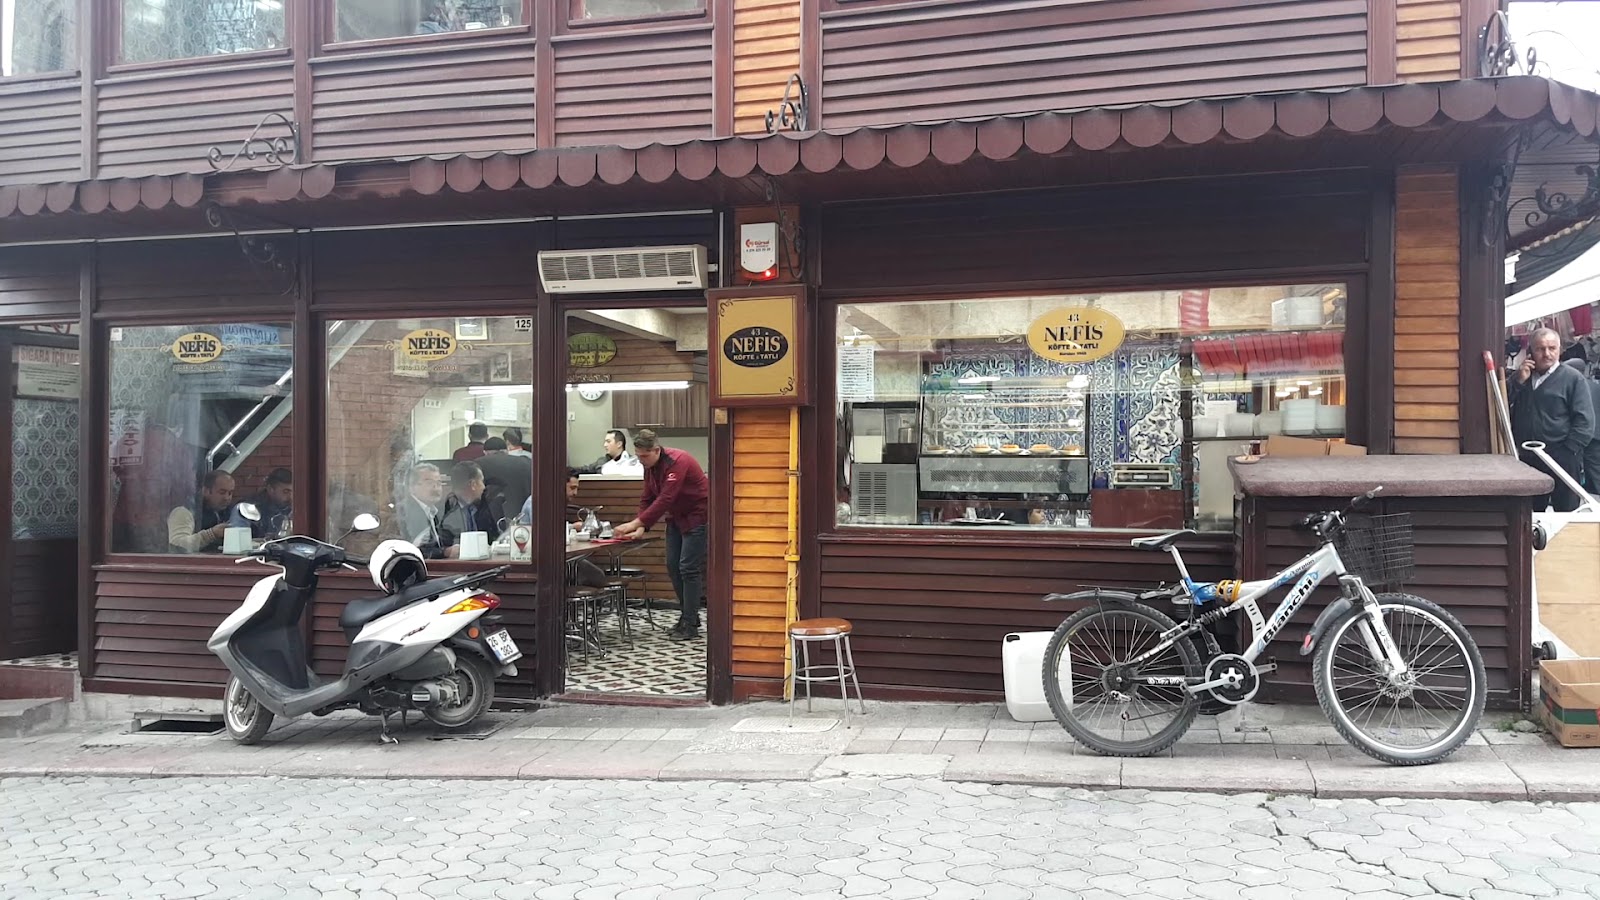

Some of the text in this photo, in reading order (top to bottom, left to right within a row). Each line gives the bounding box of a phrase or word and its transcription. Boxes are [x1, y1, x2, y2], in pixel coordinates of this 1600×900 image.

[1067, 313, 1080, 322] 43
[515, 319, 531, 328] 125
[751, 328, 761, 336] 43
[1044, 320, 1104, 342] NEFİS
[178, 336, 217, 353] NEFİS
[408, 333, 450, 350] NEFİS
[731, 331, 781, 353] NEFİS
[1048, 343, 1070, 351] KÖFTE
[733, 353, 756, 361] KÖFTE
[1262, 577, 1314, 644] Bianchi
[488, 636, 499, 647] 26
